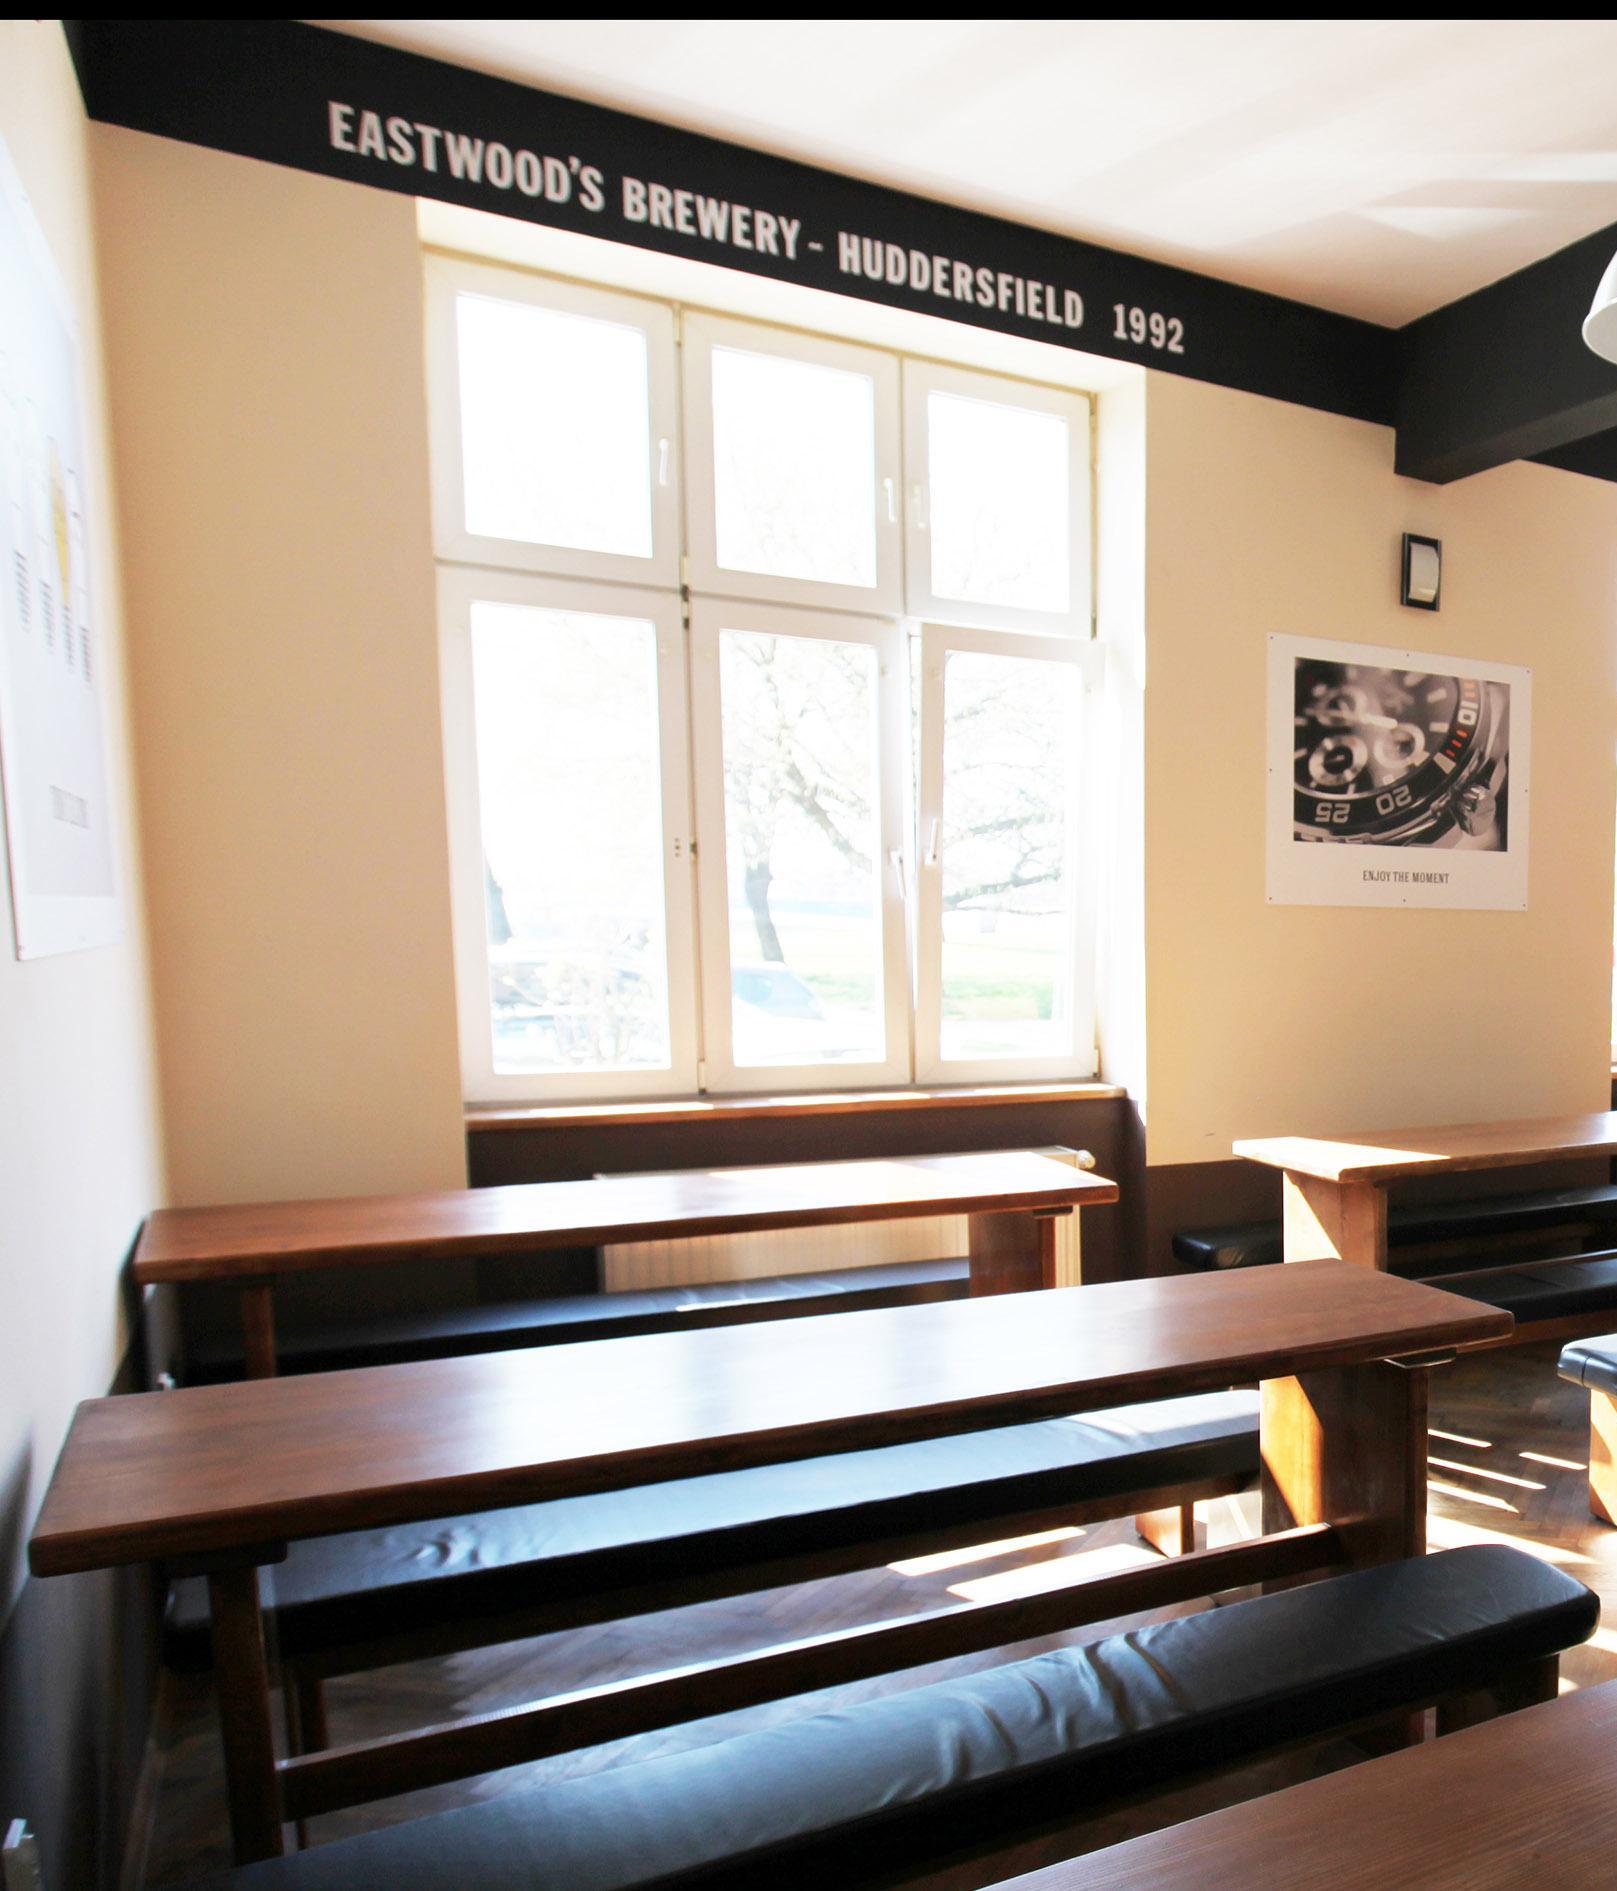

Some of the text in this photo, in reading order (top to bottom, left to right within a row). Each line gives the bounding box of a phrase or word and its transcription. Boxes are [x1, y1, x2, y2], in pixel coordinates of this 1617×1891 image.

[328, 101, 605, 212] EASTWOOD'S
[622, 176, 801, 260] BREWERY
[838, 231, 1084, 328] HUDDERSFIELD
[1113, 303, 1185, 354] 1992
[1362, 870, 1450, 884] ENJOY THE MOMENT
